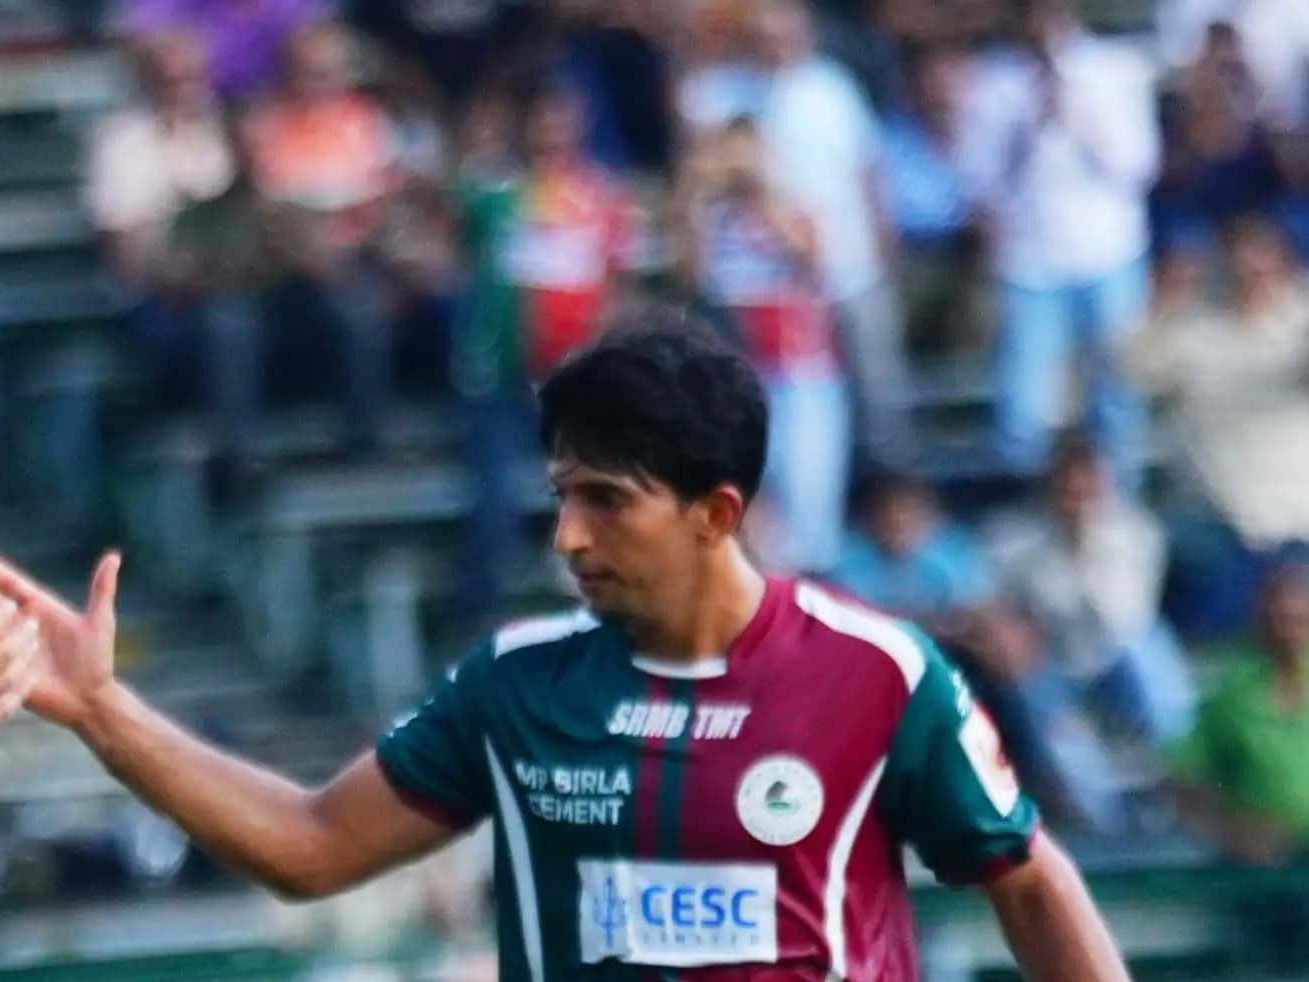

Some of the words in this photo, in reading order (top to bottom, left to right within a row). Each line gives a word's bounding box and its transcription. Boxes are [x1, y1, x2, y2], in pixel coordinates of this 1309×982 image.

[693, 703, 752, 740] TMT
[553, 766, 631, 795] BIRLA
[529, 794, 624, 826] CEMENT
[641, 885, 758, 928] CESC
